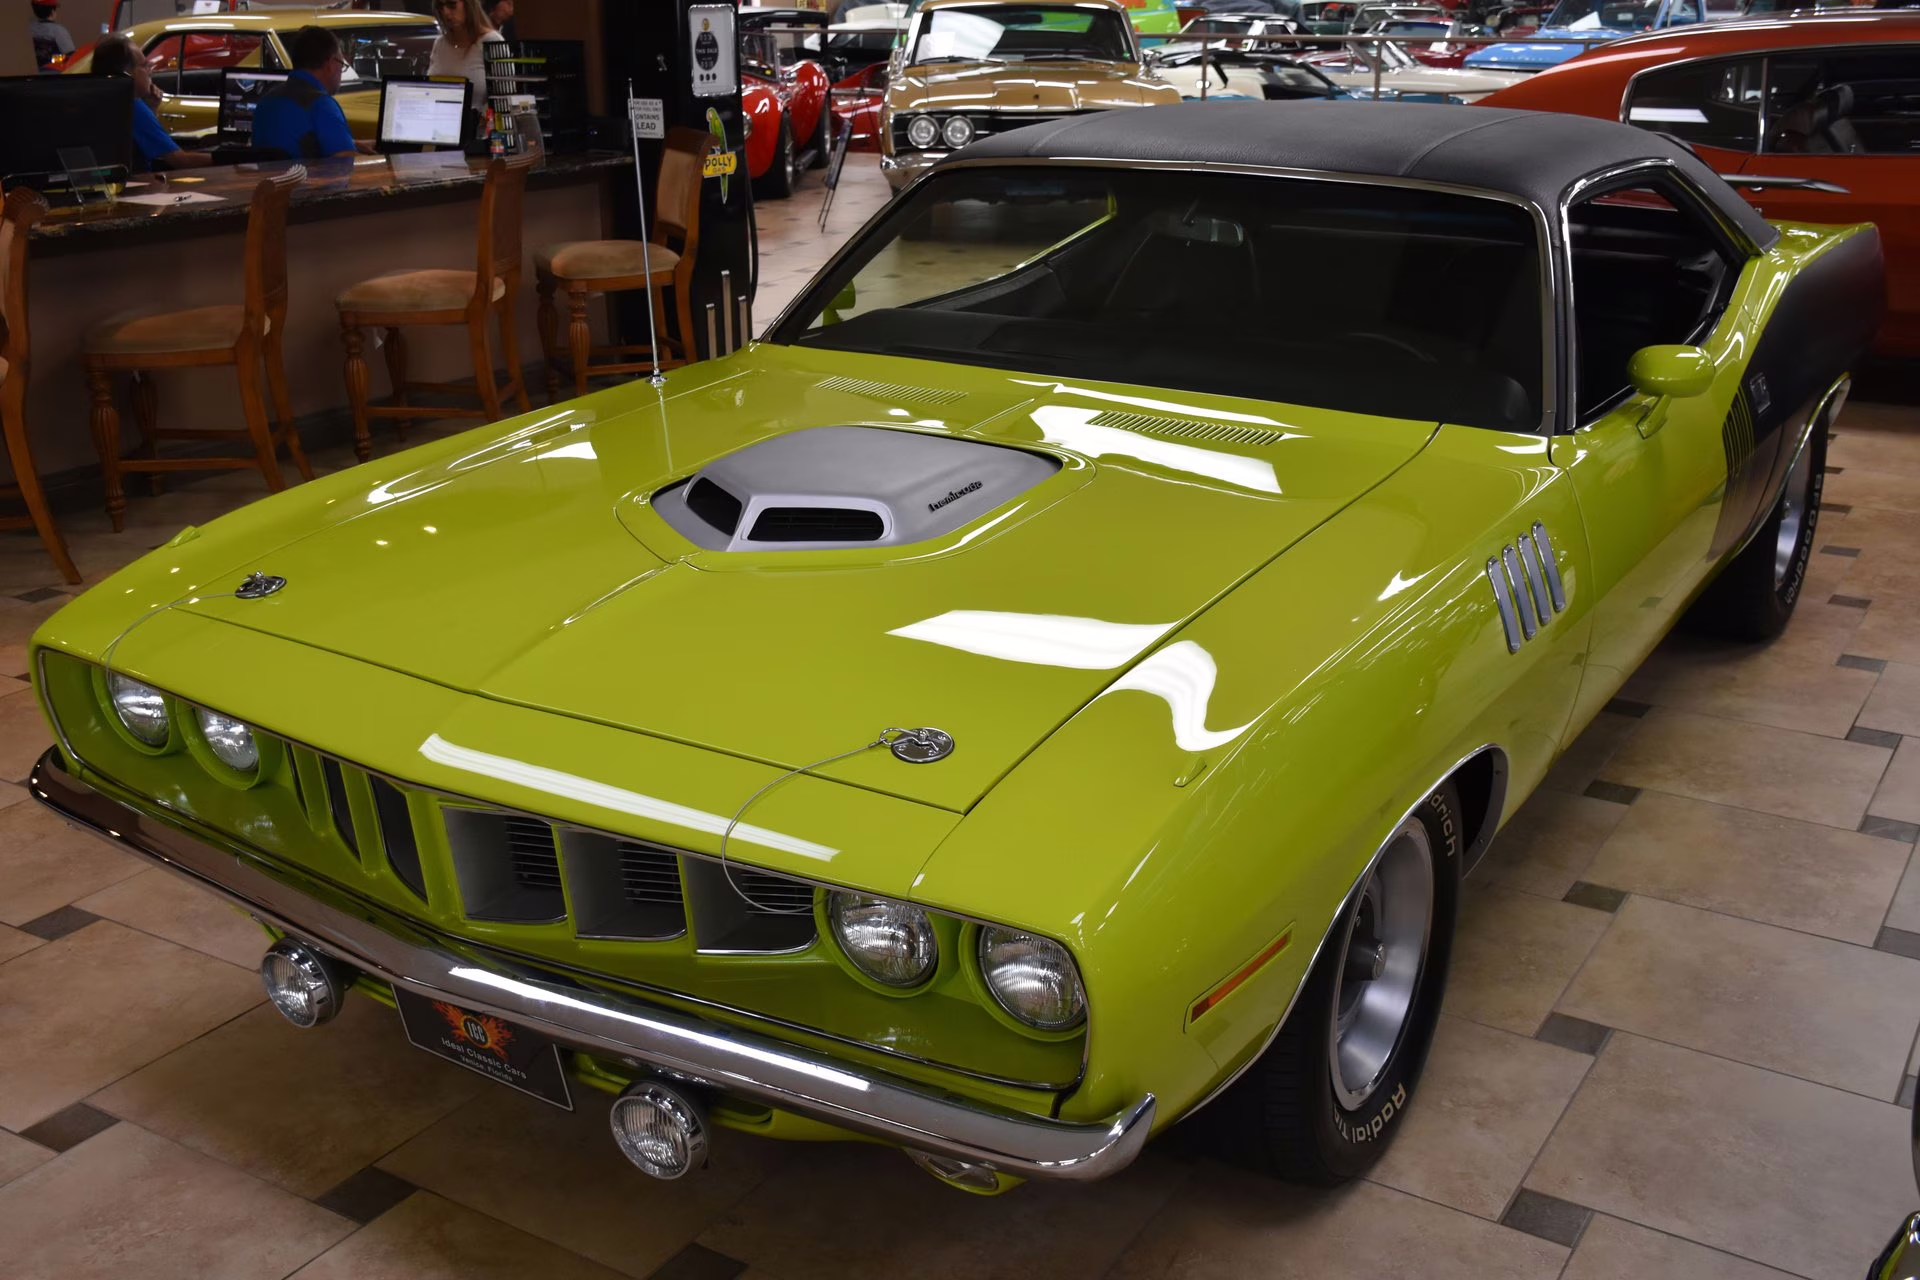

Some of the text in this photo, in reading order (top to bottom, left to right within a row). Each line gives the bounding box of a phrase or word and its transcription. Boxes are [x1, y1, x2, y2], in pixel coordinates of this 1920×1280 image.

[634, 113, 660, 121] ONTAINS
[636, 122, 656, 130] LEAD
[704, 156, 732, 170] POLLY
[467, 1021, 486, 1042] ICC
[441, 1037, 527, 1079] Ideal Classic Cars
[487, 1066, 513, 1081] Florida
[1352, 1082, 1407, 1144] Radial
